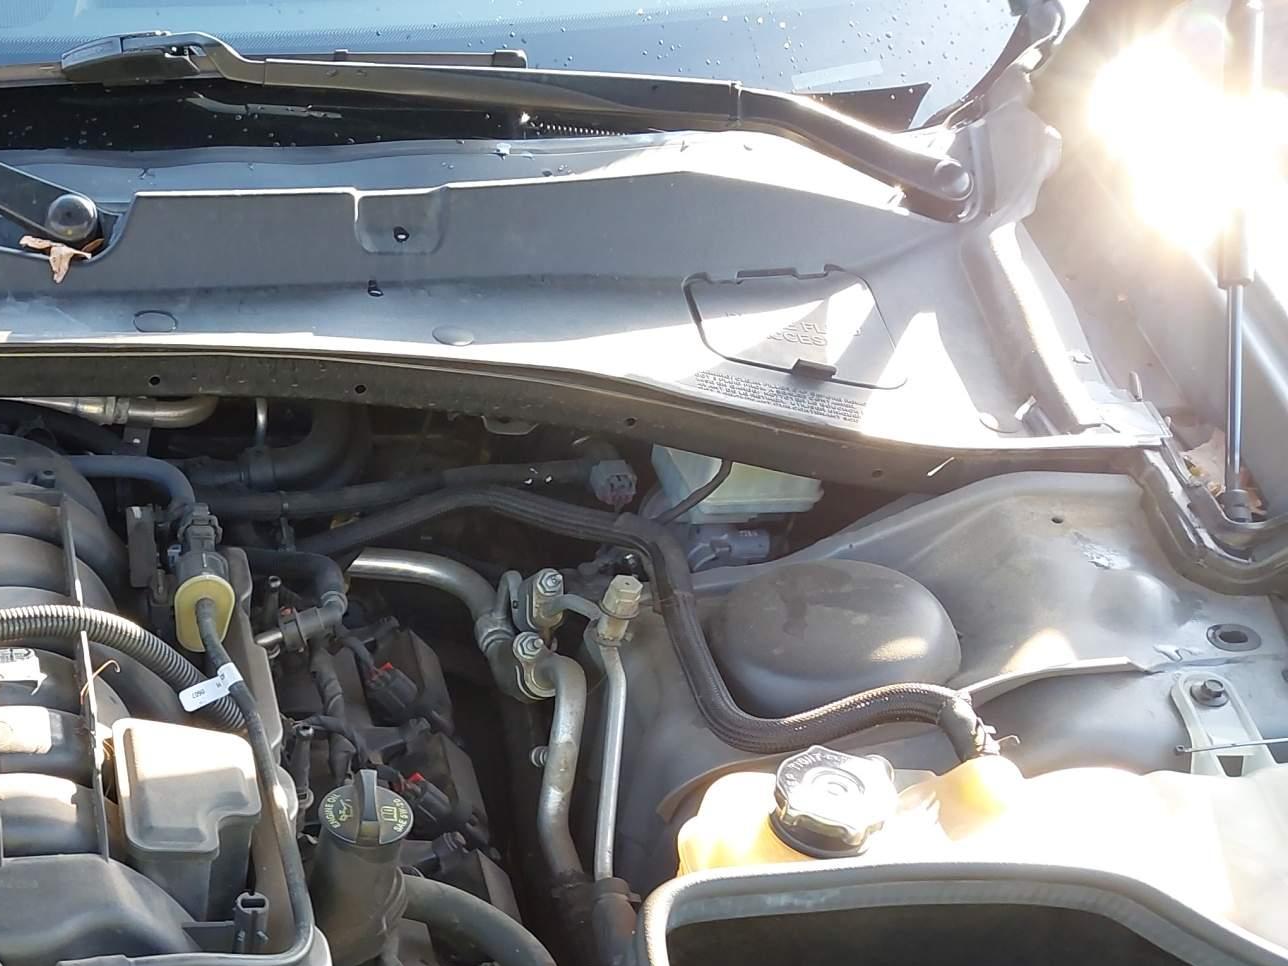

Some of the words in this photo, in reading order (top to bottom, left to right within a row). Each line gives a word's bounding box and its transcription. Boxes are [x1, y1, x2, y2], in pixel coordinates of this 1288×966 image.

[326, 793, 341, 804] OIL
[323, 803, 341, 829] ENGINE
[393, 818, 408, 833] SAE
